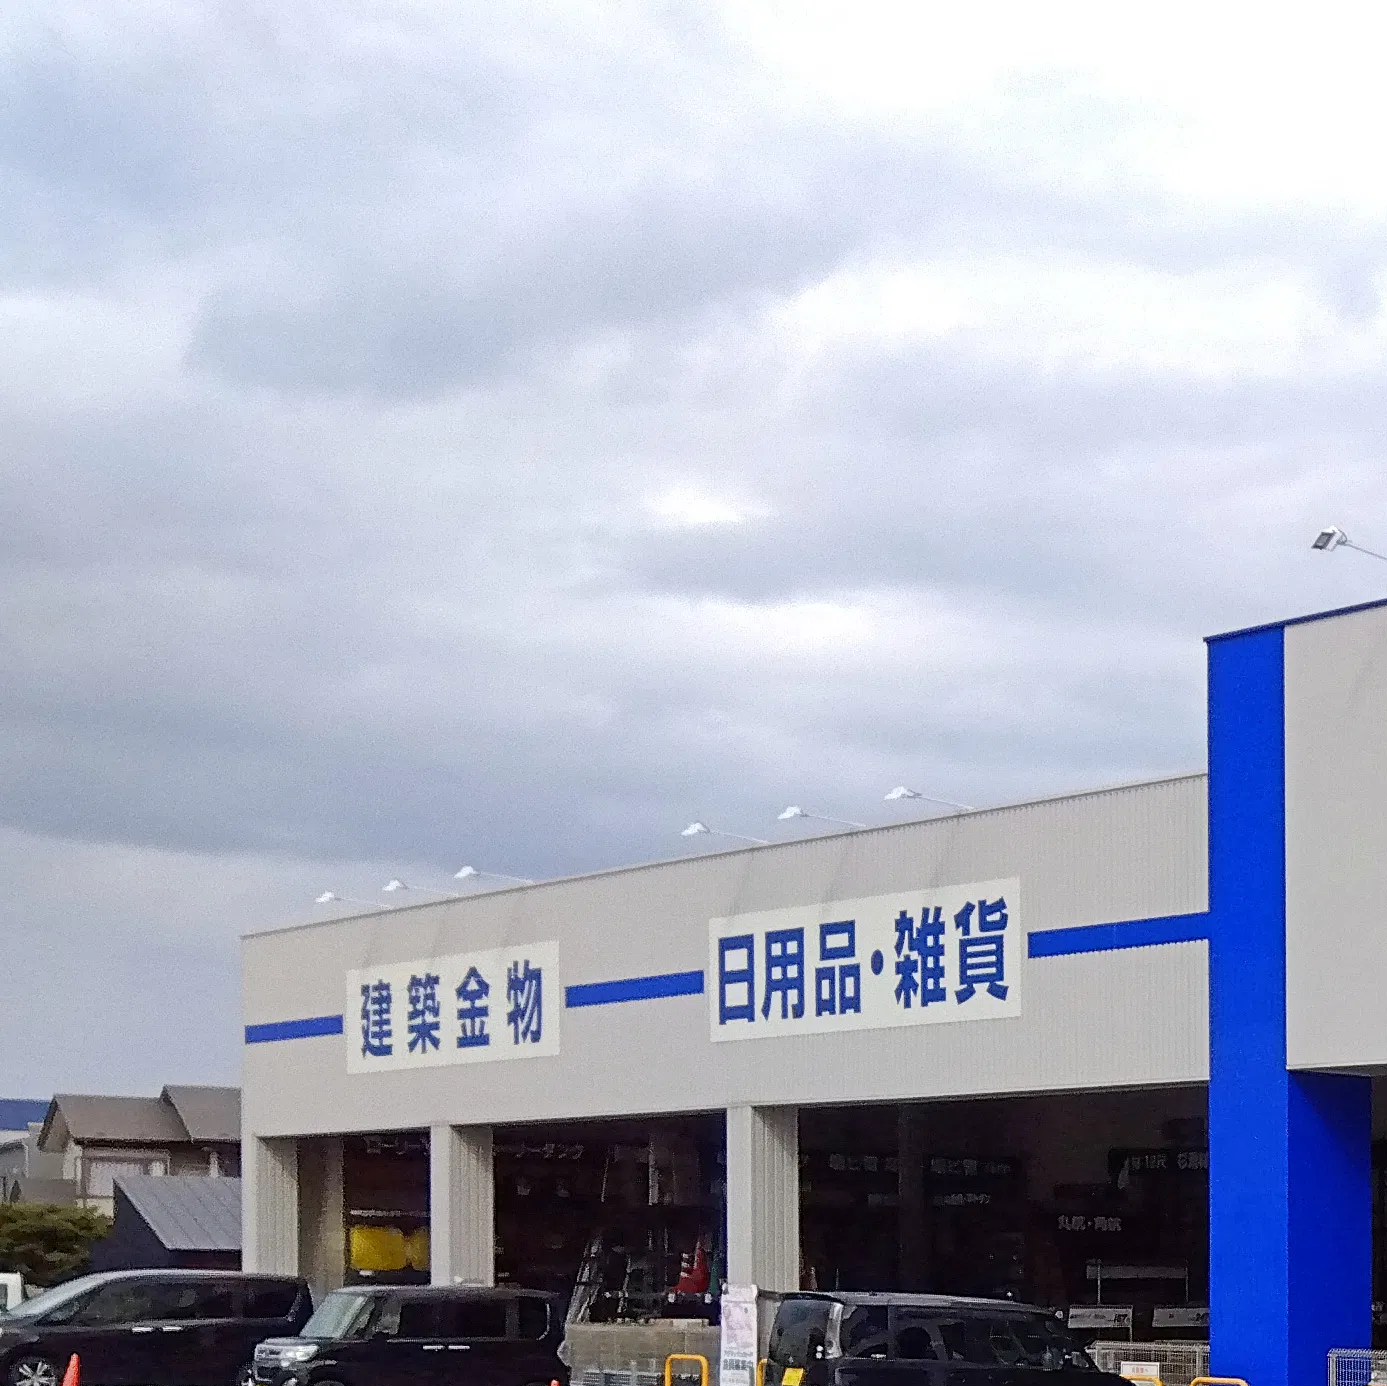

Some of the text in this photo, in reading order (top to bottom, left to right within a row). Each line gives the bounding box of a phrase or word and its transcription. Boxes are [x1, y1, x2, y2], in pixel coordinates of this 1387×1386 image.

[360, 959, 543, 1059] 建築金物
[718, 896, 1009, 1026] 日用品・雑貨
